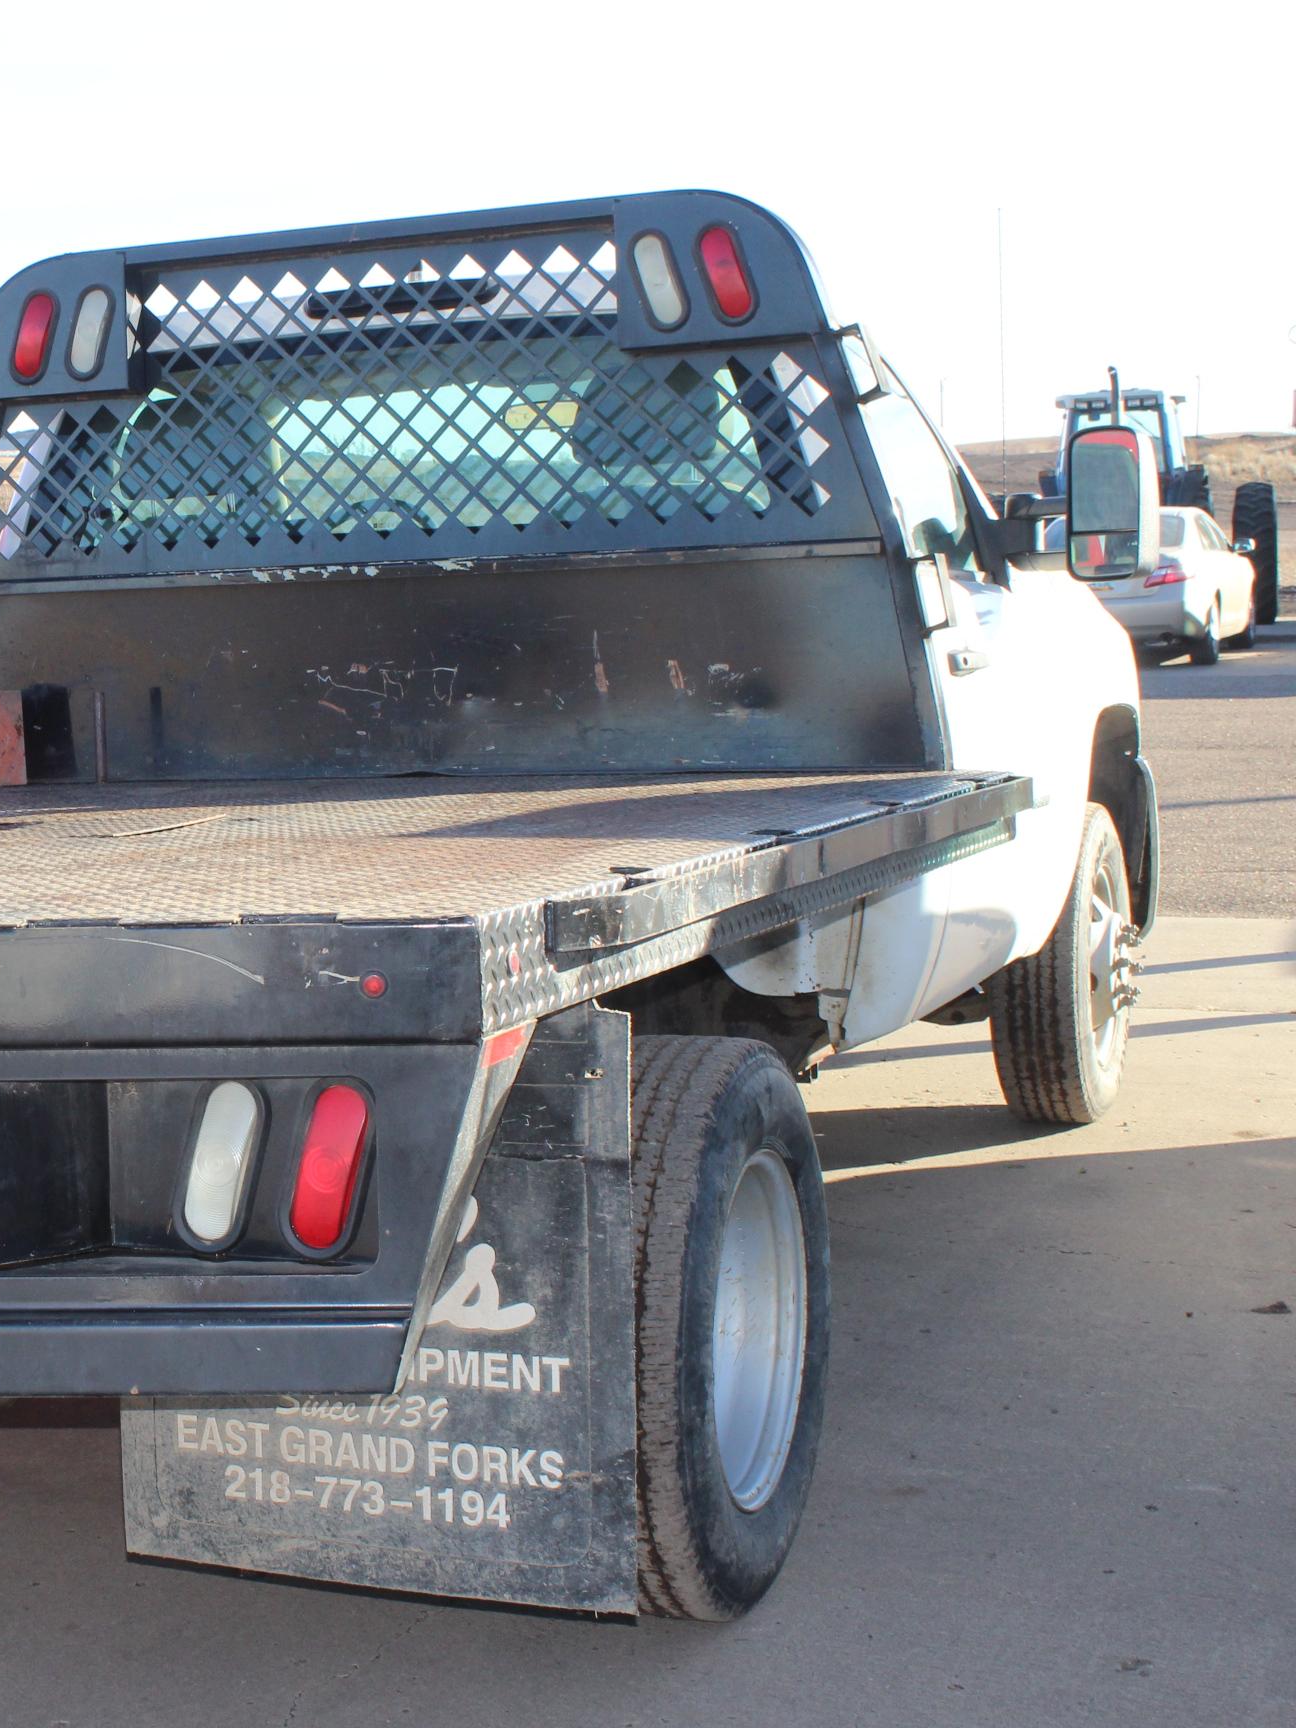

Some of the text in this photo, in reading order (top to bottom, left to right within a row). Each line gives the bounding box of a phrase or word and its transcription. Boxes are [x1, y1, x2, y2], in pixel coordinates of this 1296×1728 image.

[275, 1394, 449, 1430] Since 1939
[176, 1414, 564, 1489] EAST GRAND FORKS
[223, 1464, 511, 1529] 218-773-1194
